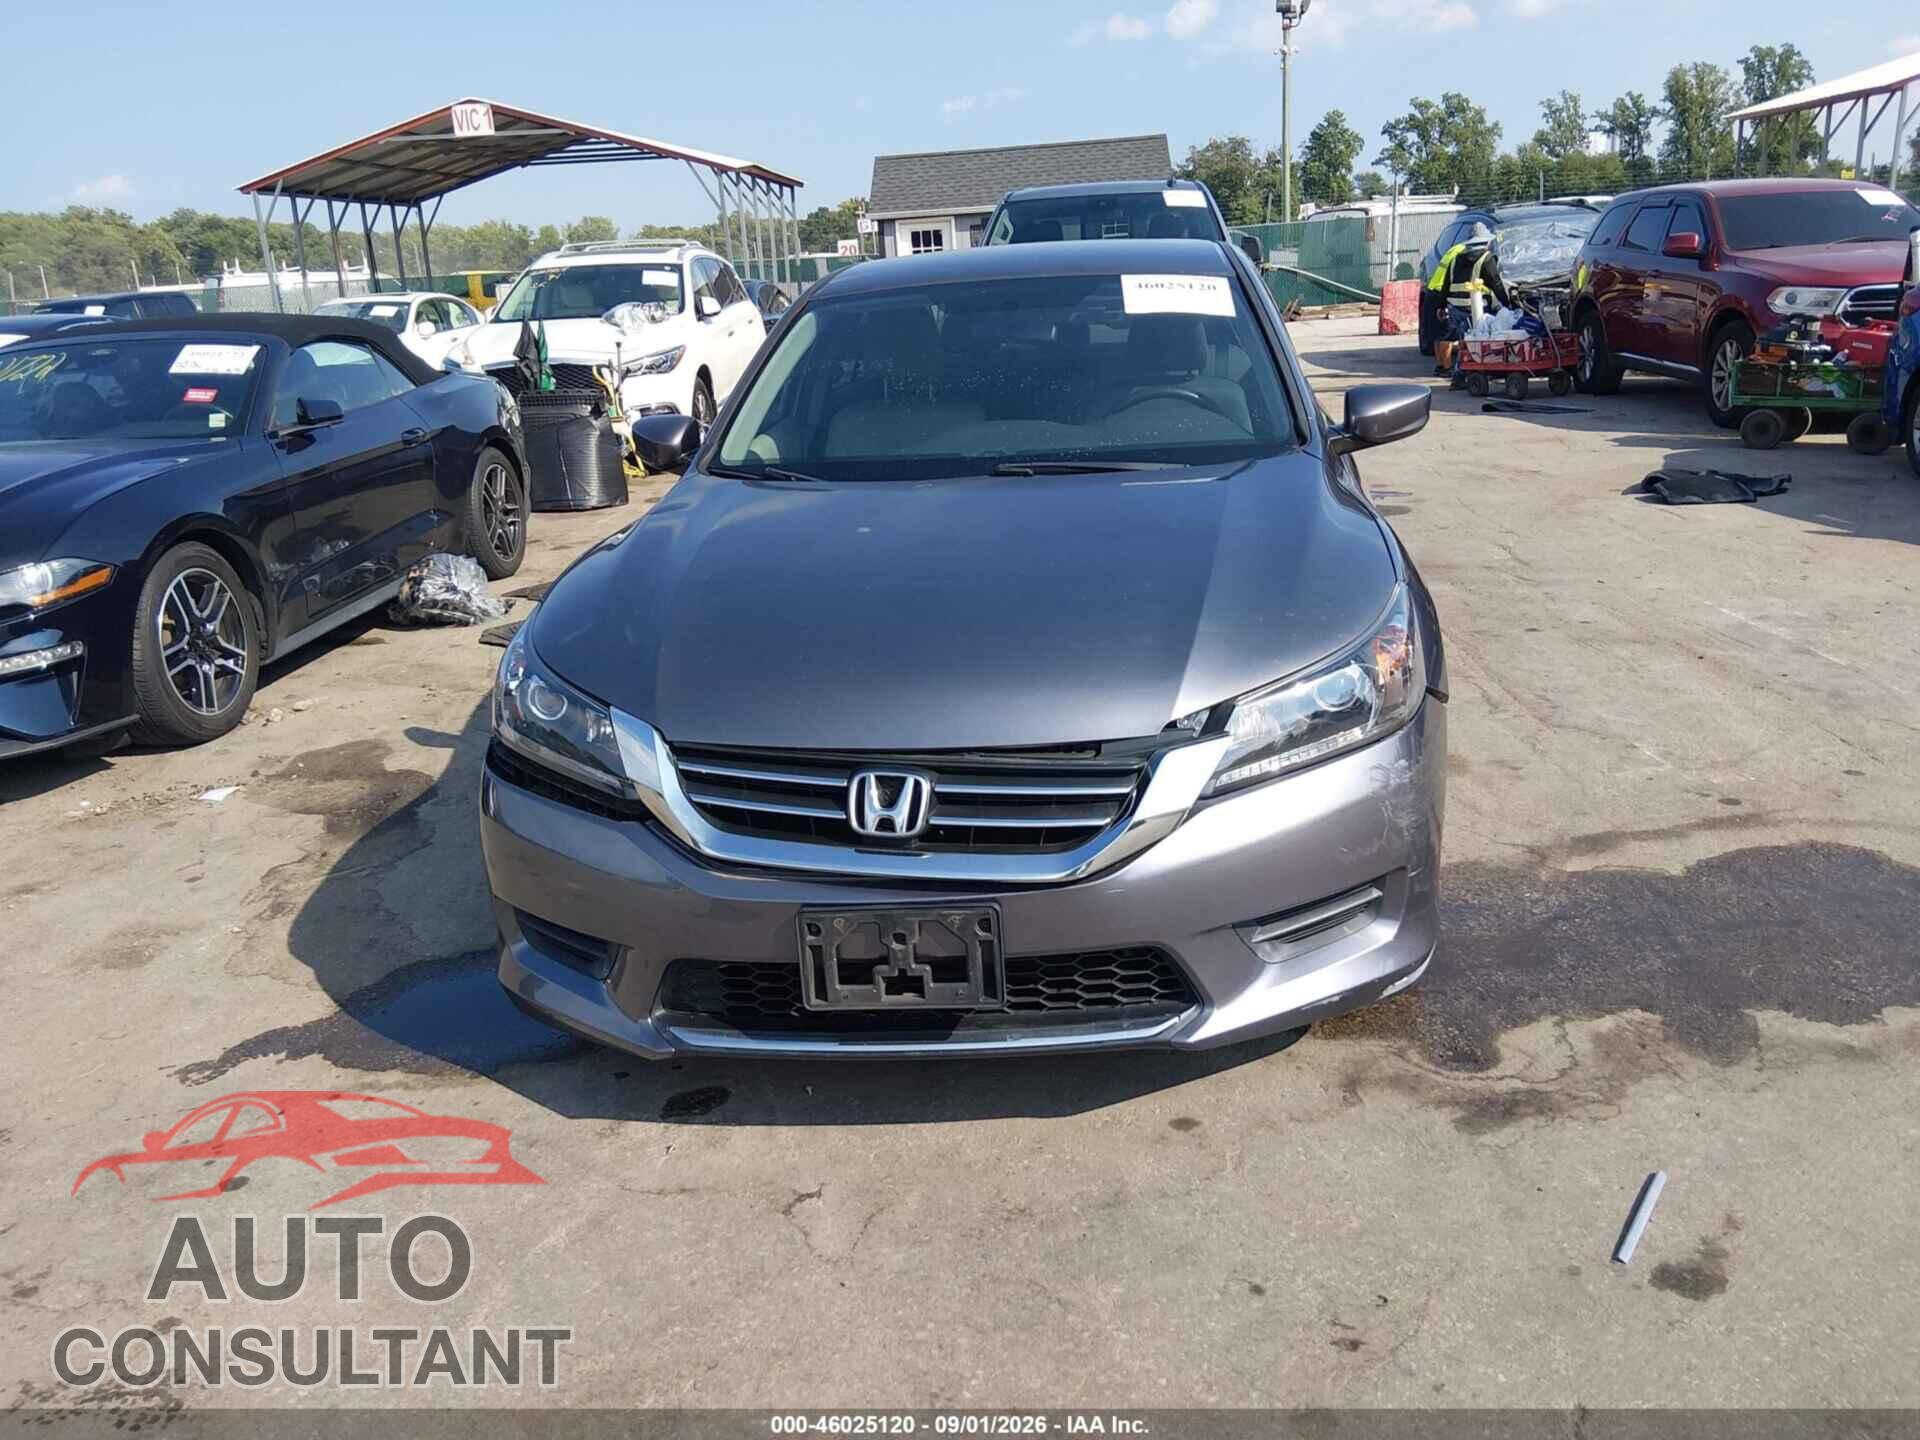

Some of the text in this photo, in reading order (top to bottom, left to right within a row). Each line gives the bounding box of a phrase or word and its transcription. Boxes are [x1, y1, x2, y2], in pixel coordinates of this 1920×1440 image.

[454, 106, 493, 131] VIC 1
[840, 244, 857, 257] 20
